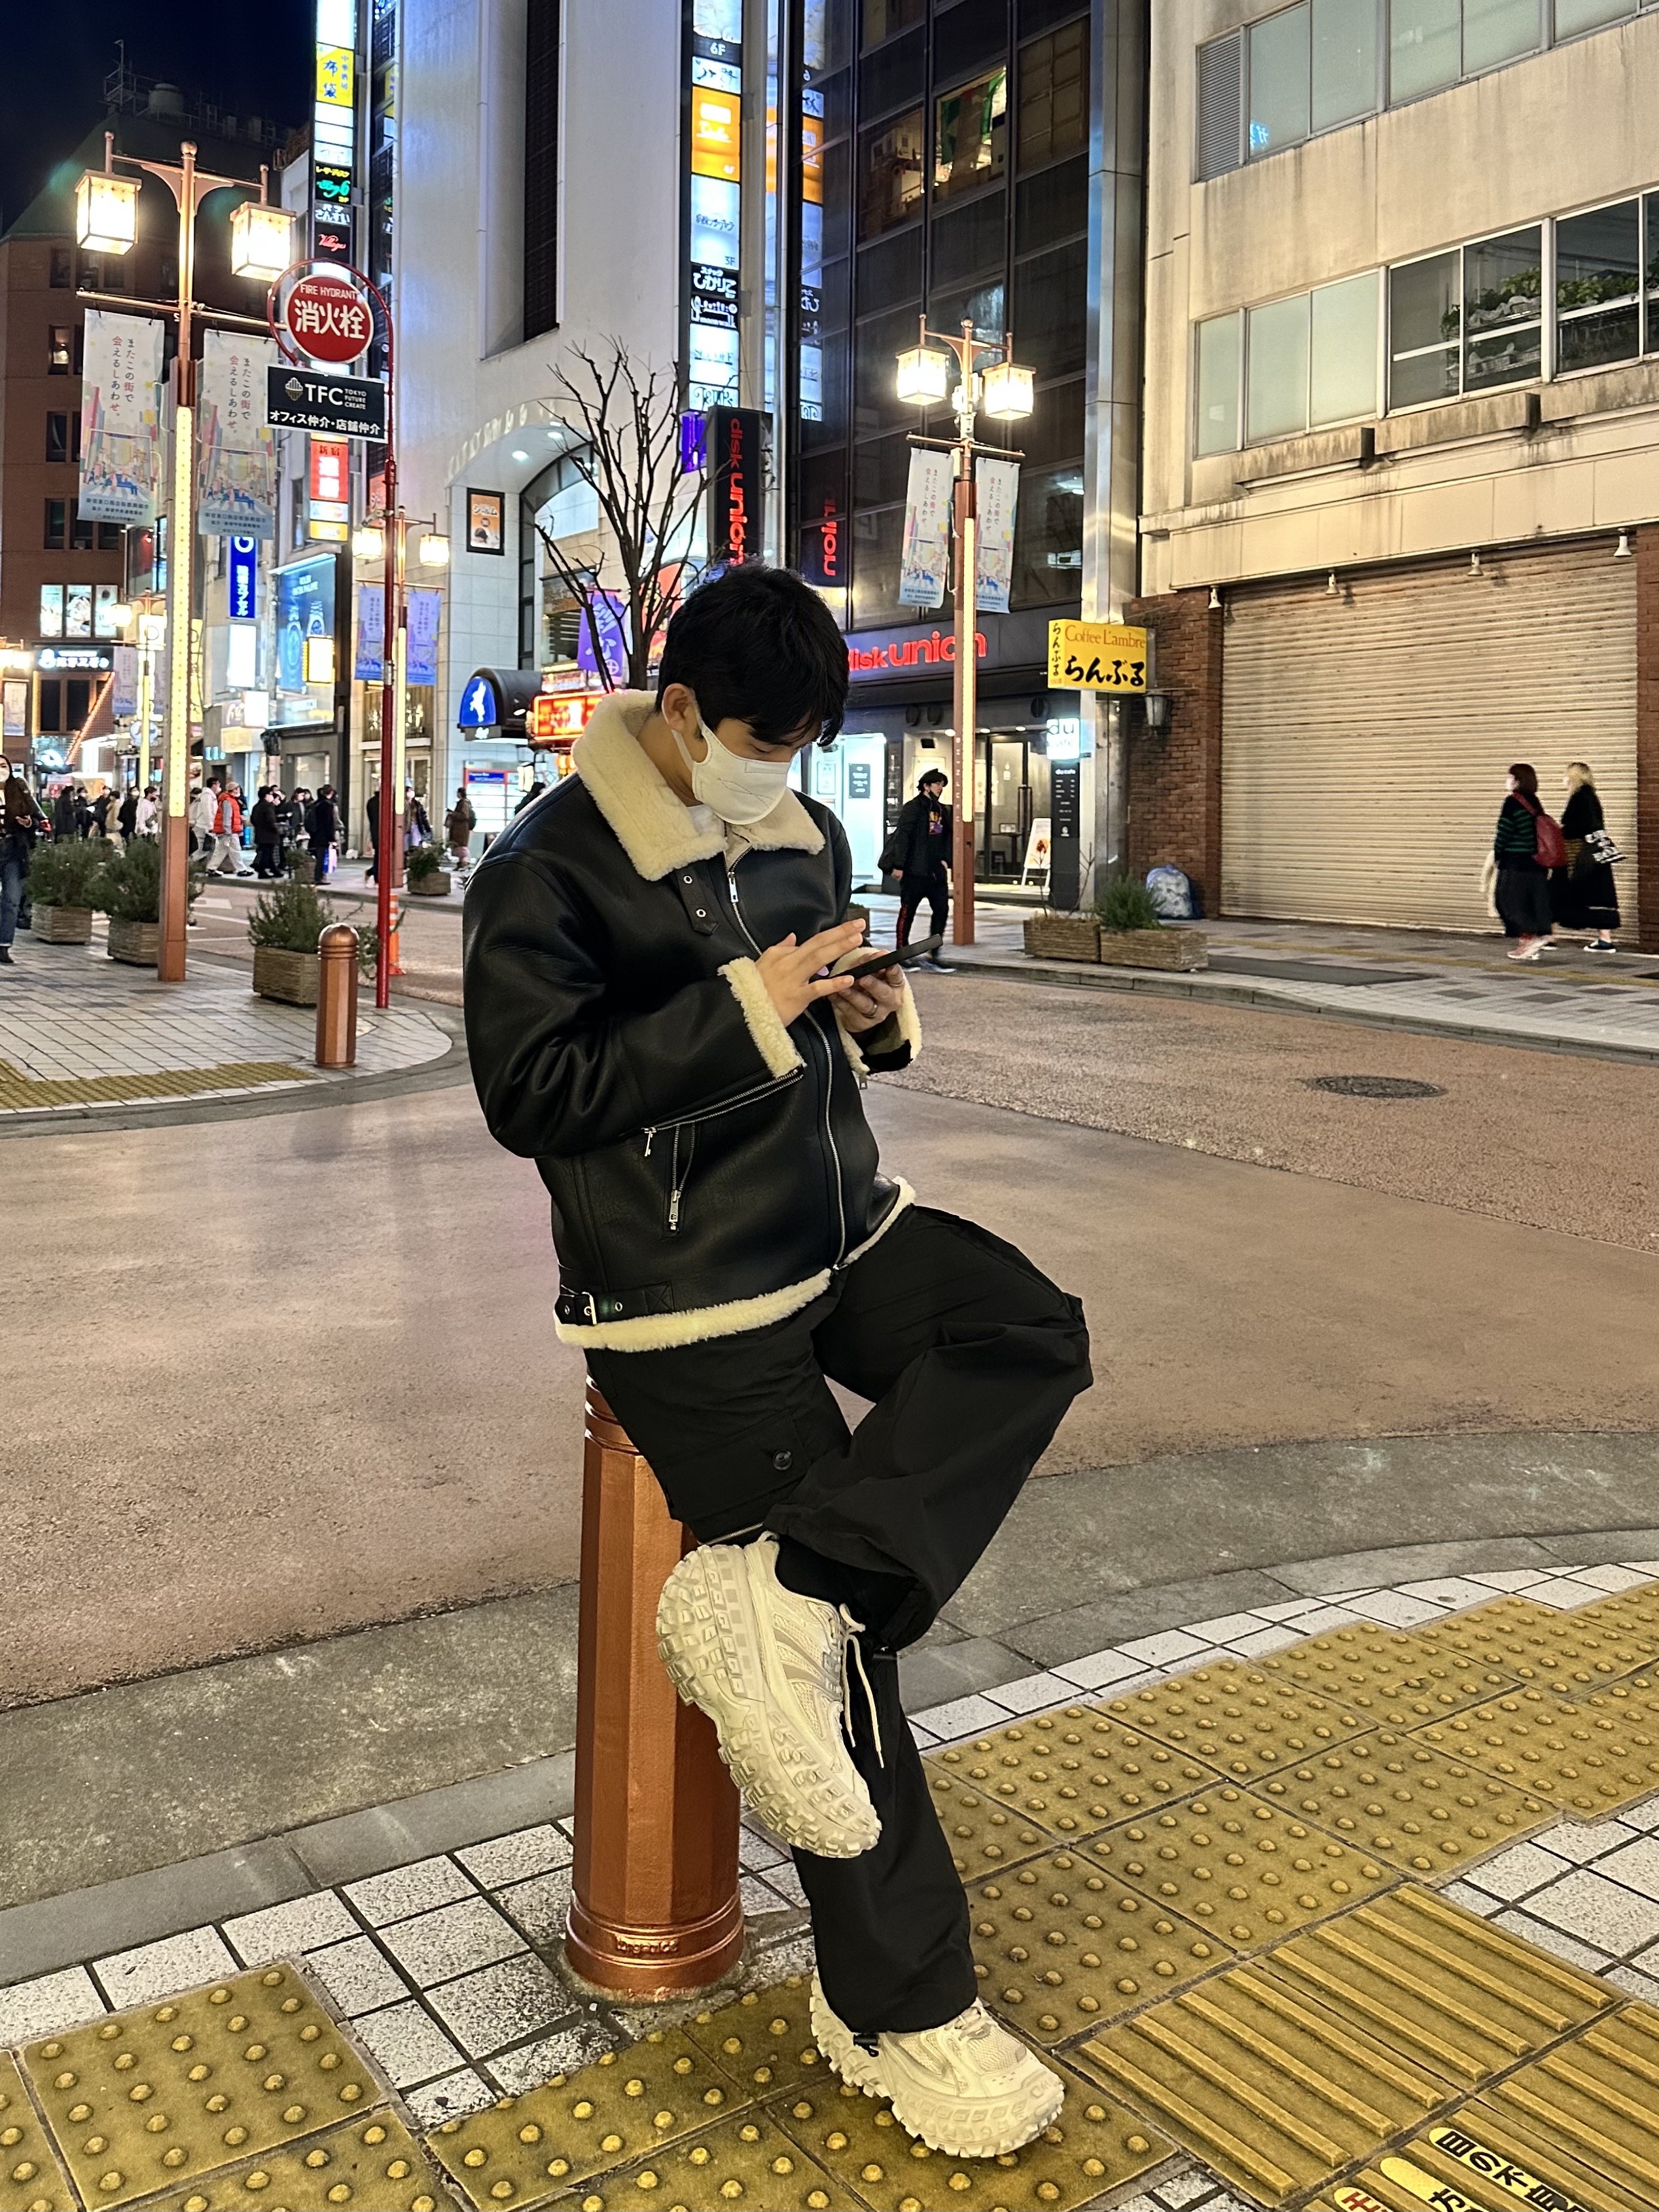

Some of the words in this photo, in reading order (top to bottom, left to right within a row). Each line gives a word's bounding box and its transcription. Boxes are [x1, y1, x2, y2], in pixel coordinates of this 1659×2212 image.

[709, 42, 726, 56] 6F
[724, 256, 736, 266] 3F
[300, 283, 318, 295] FIRE
[320, 286, 357, 300] HYDRANT
[294, 298, 366, 340] 消火栓
[109, 335, 123, 417] 会えるしあわせ。
[123, 338, 135, 403] またこの街で
[227, 355, 239, 434] 会えるしあわせ。
[240, 357, 252, 420] またこの街で
[304, 384, 344, 406] TFC
[344, 388, 367, 397] TOKYO
[344, 395, 366, 403] FUTURE
[344, 401, 366, 410] CREATE
[270, 410, 381, 435] オフィス仲介・店舗仲介
[730, 418, 743, 469] disk
[728, 472, 748, 566] union
[1051, 623, 1061, 676] らんぶる
[1065, 625, 1102, 645] Coffee
[1103, 628, 1146, 649] L'ambre
[1064, 655, 1145, 687] らんぶる
[1048, 718, 1075, 735] du
[1435, 2130, 1592, 2212] 目の不自
